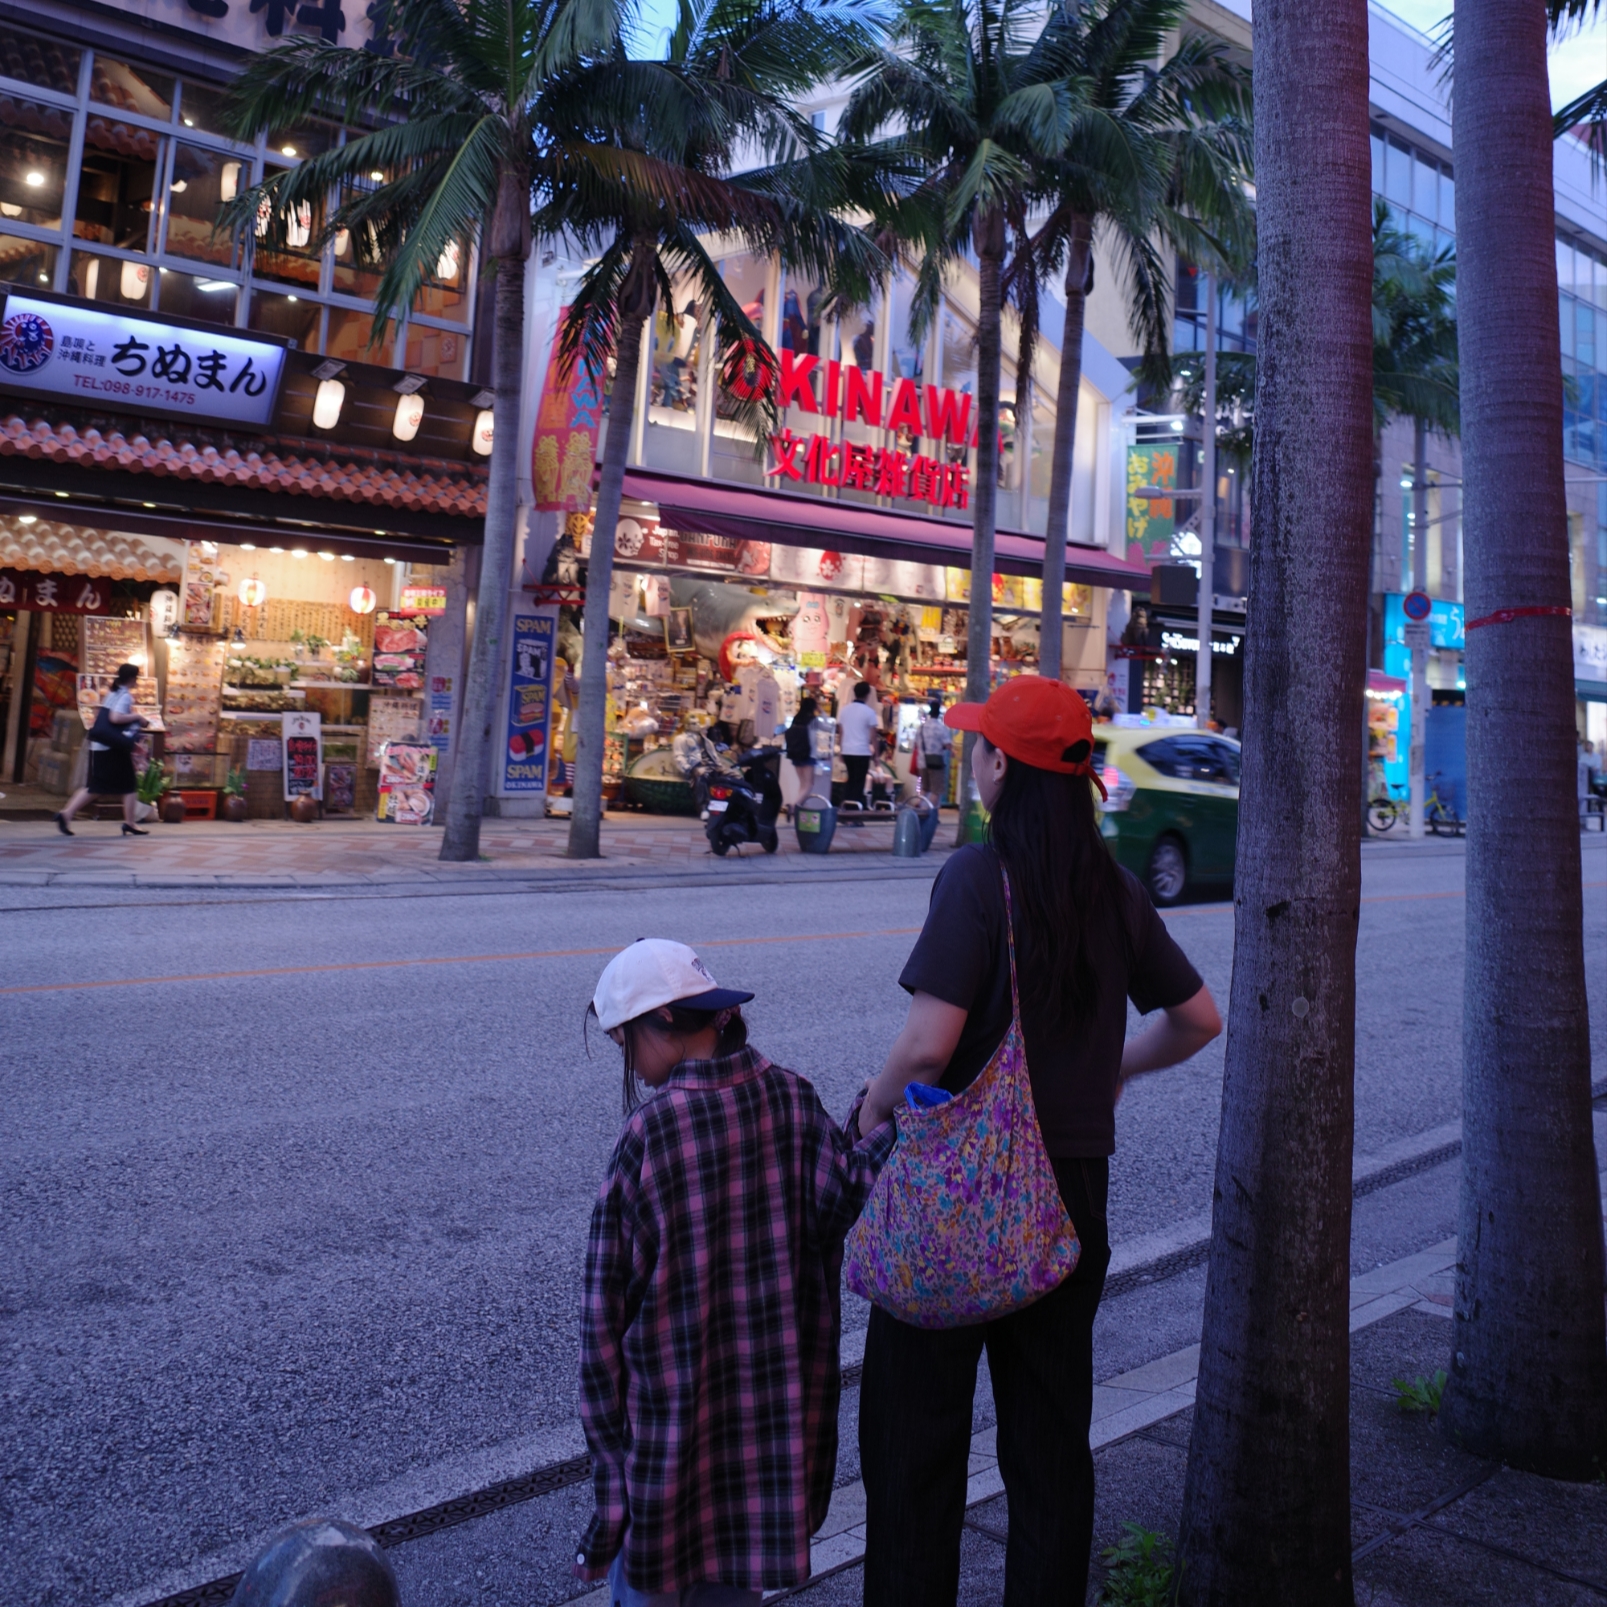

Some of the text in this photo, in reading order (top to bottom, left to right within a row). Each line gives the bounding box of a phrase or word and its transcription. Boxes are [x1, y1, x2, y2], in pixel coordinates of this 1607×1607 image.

[57, 348, 107, 367] 沖縄料理
[111, 335, 267, 397] ちぬまん
[74, 374, 196, 405] TEL:098-917-1475
[763, 428, 970, 510] 文化屋雑貨店
[515, 618, 552, 635] SPAM
[516, 643, 541, 657] SPAM
[521, 691, 545, 705] SPAM
[507, 764, 543, 779] SPAM
[505, 781, 543, 789] OKINAWA
